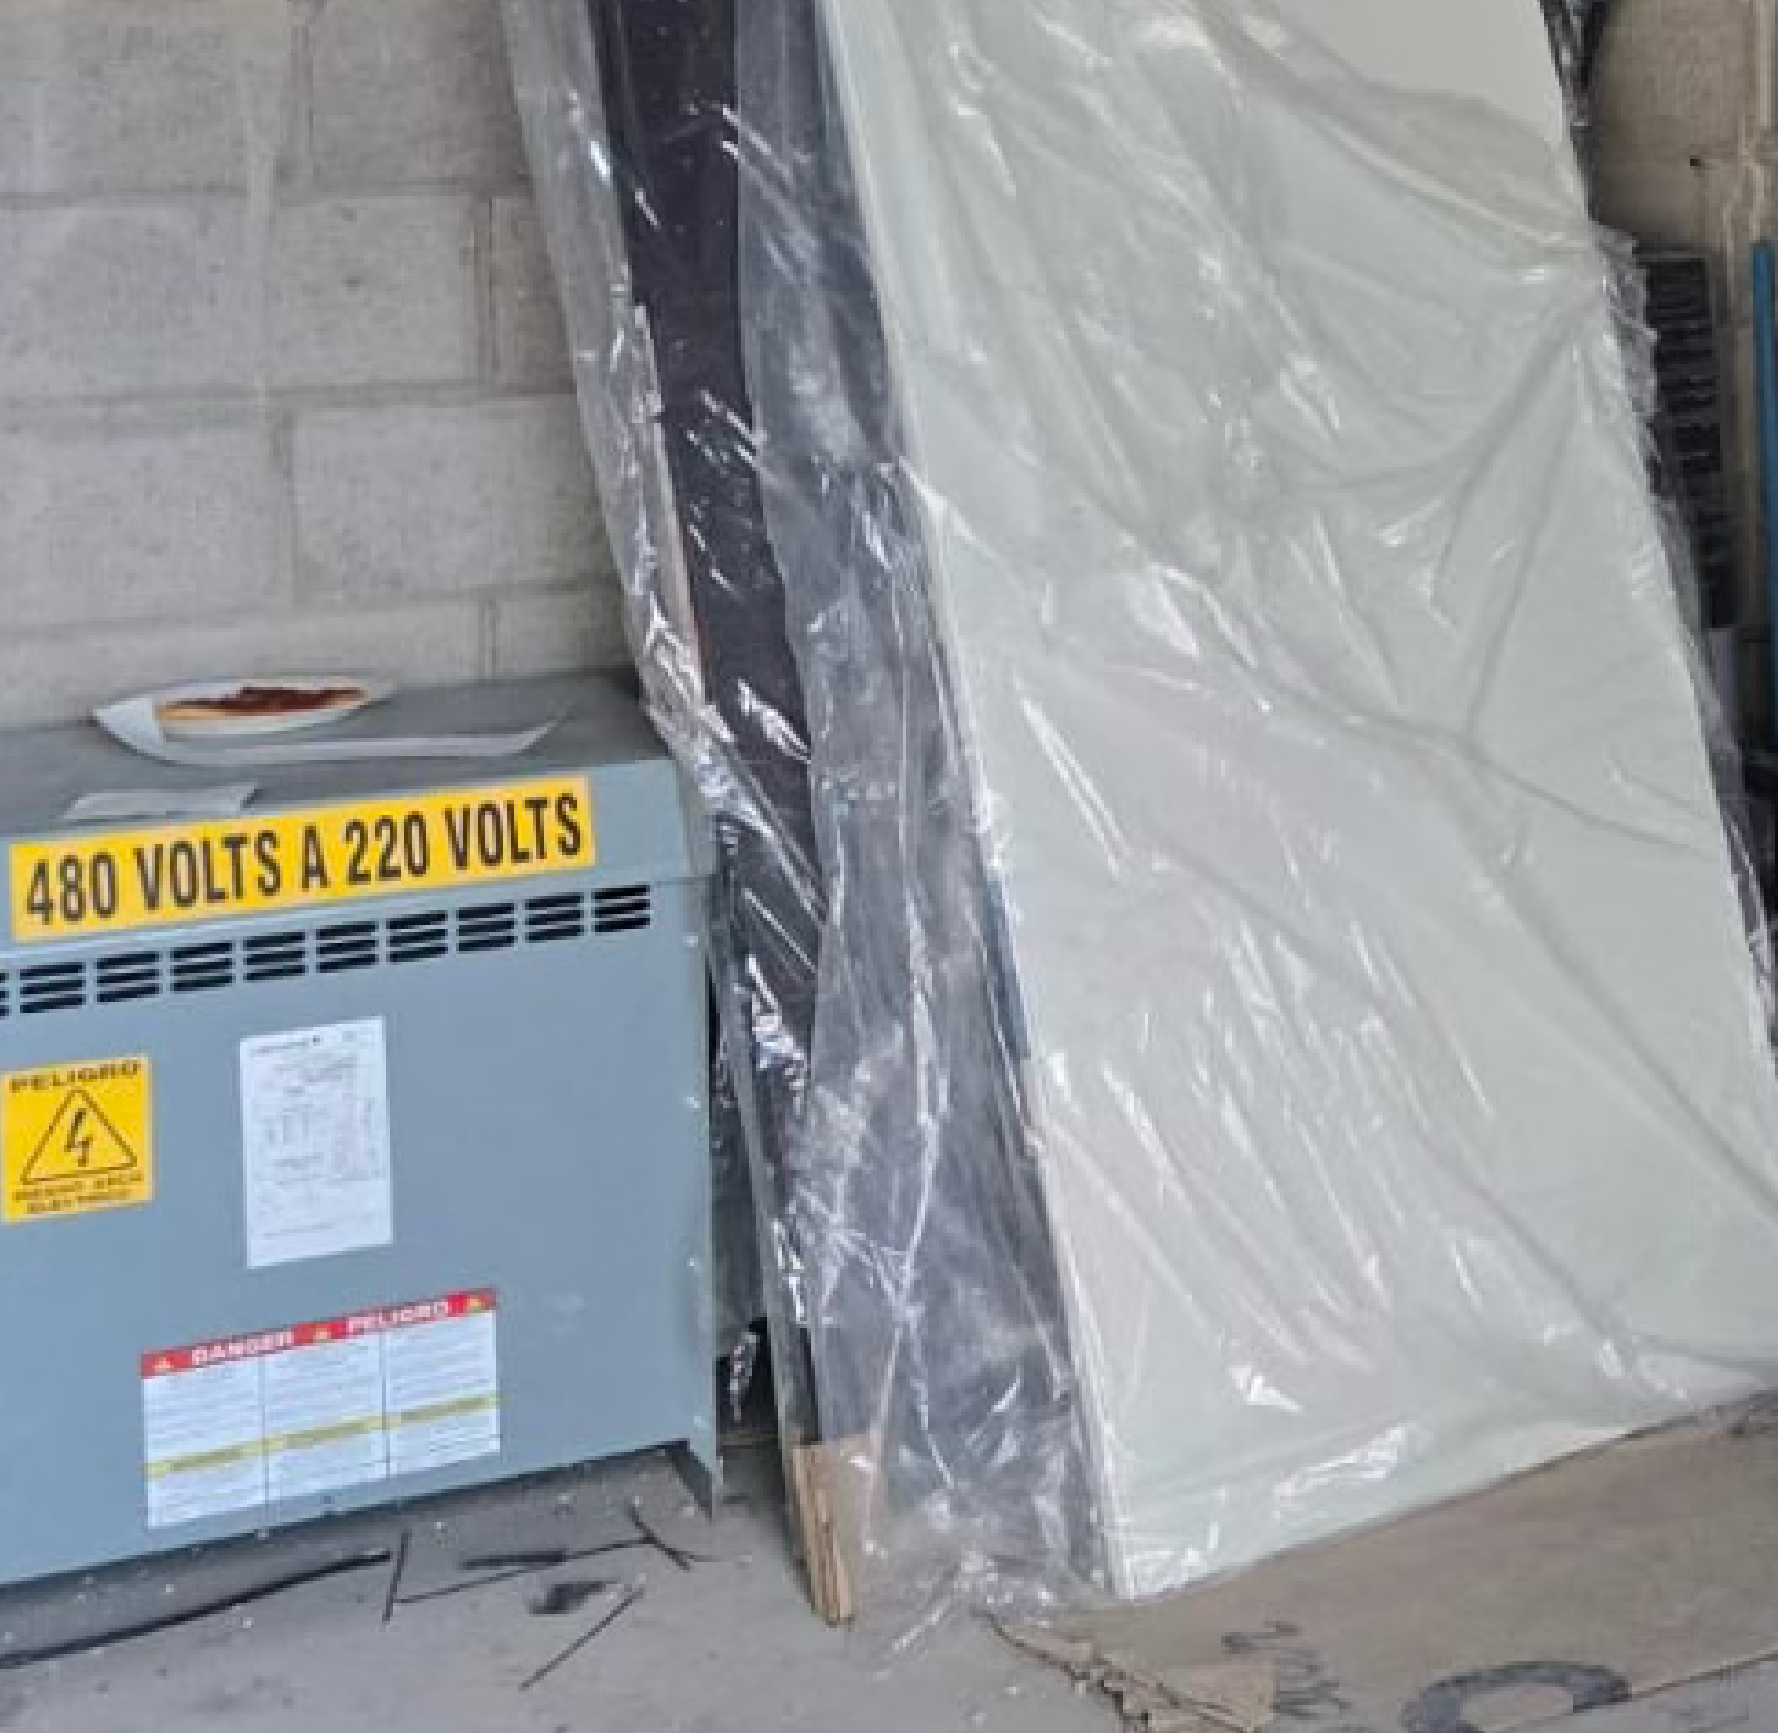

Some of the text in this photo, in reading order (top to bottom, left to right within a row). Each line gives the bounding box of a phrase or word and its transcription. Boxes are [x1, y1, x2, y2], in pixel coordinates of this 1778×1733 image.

[26, 792, 581, 926] 480 VOLTS A 220 VOLTS
[9, 1060, 142, 1094] PELIGRO
[191, 1299, 450, 1366] DANGER PELIGRO
